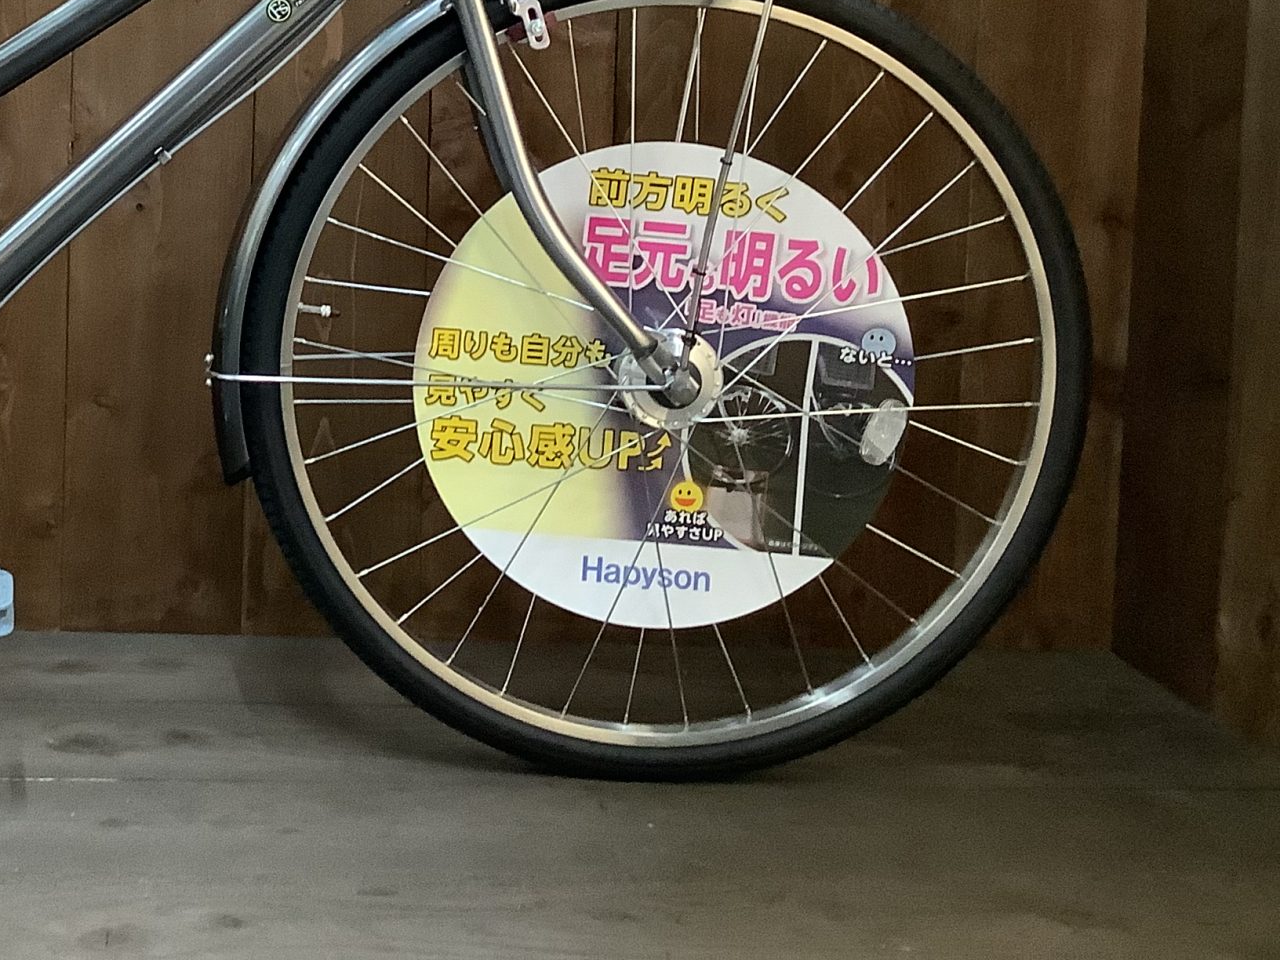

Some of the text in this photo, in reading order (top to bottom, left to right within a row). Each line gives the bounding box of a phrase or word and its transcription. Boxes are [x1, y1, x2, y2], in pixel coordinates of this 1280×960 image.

[589, 168, 790, 223] 前方明るく
[428, 327, 612, 368] 周りも自分も
[425, 373, 546, 412] 見やすく
[430, 414, 646, 470] 安心感UP
[664, 509, 708, 525] あれば
[581, 555, 711, 592] Hapyson
